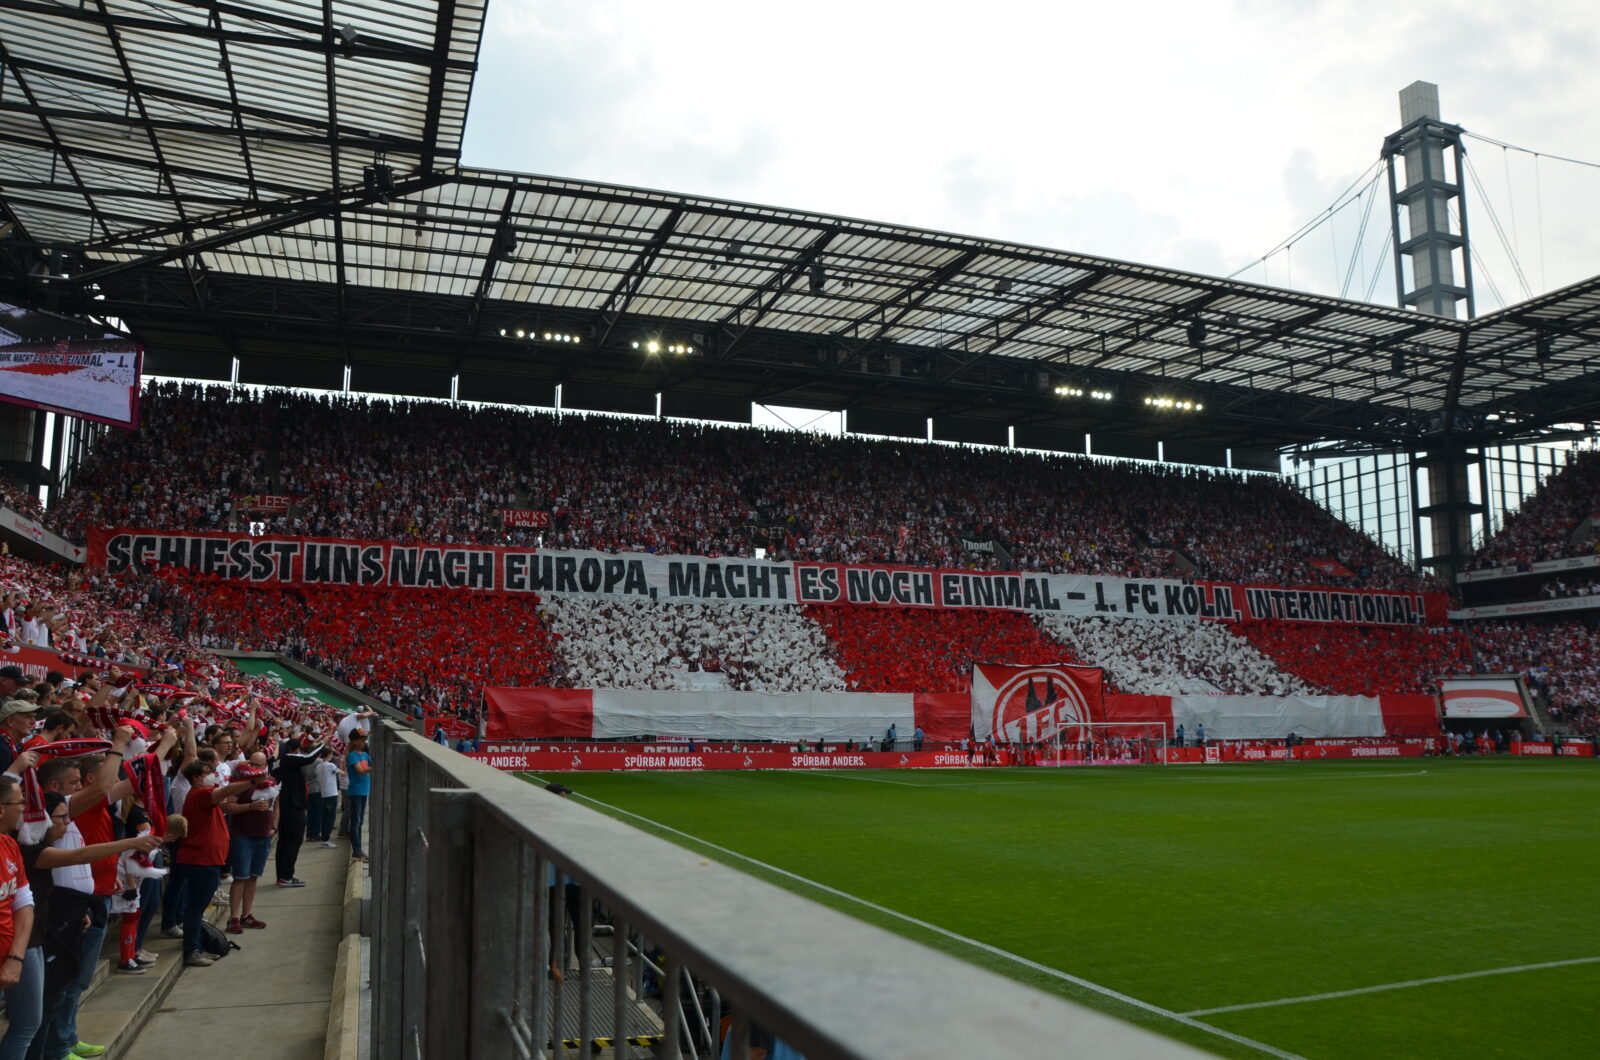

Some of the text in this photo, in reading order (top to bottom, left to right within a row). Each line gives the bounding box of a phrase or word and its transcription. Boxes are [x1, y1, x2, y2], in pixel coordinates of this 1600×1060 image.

[66, 354, 103, 367] EINMAL
[503, 510, 549, 525] HAWKS
[106, 534, 300, 582] SCHIESST
[304, 542, 385, 587] UNS
[388, 546, 495, 591] NACH
[504, 553, 657, 600] EUROPA,
[668, 561, 791, 600] MACHT
[799, 566, 841, 603] ES
[846, 568, 935, 606] NOCH
[942, 573, 1061, 611] EINMAL
[1094, 581, 1117, 612] 1.
[1124, 582, 1160, 615] FC
[1246, 588, 1427, 626] INTERNATIONAL!
[625, 755, 705, 767] SPÜRBAR ANDERS.
[792, 754, 867, 766] SPÜRBAR ANDERS.
